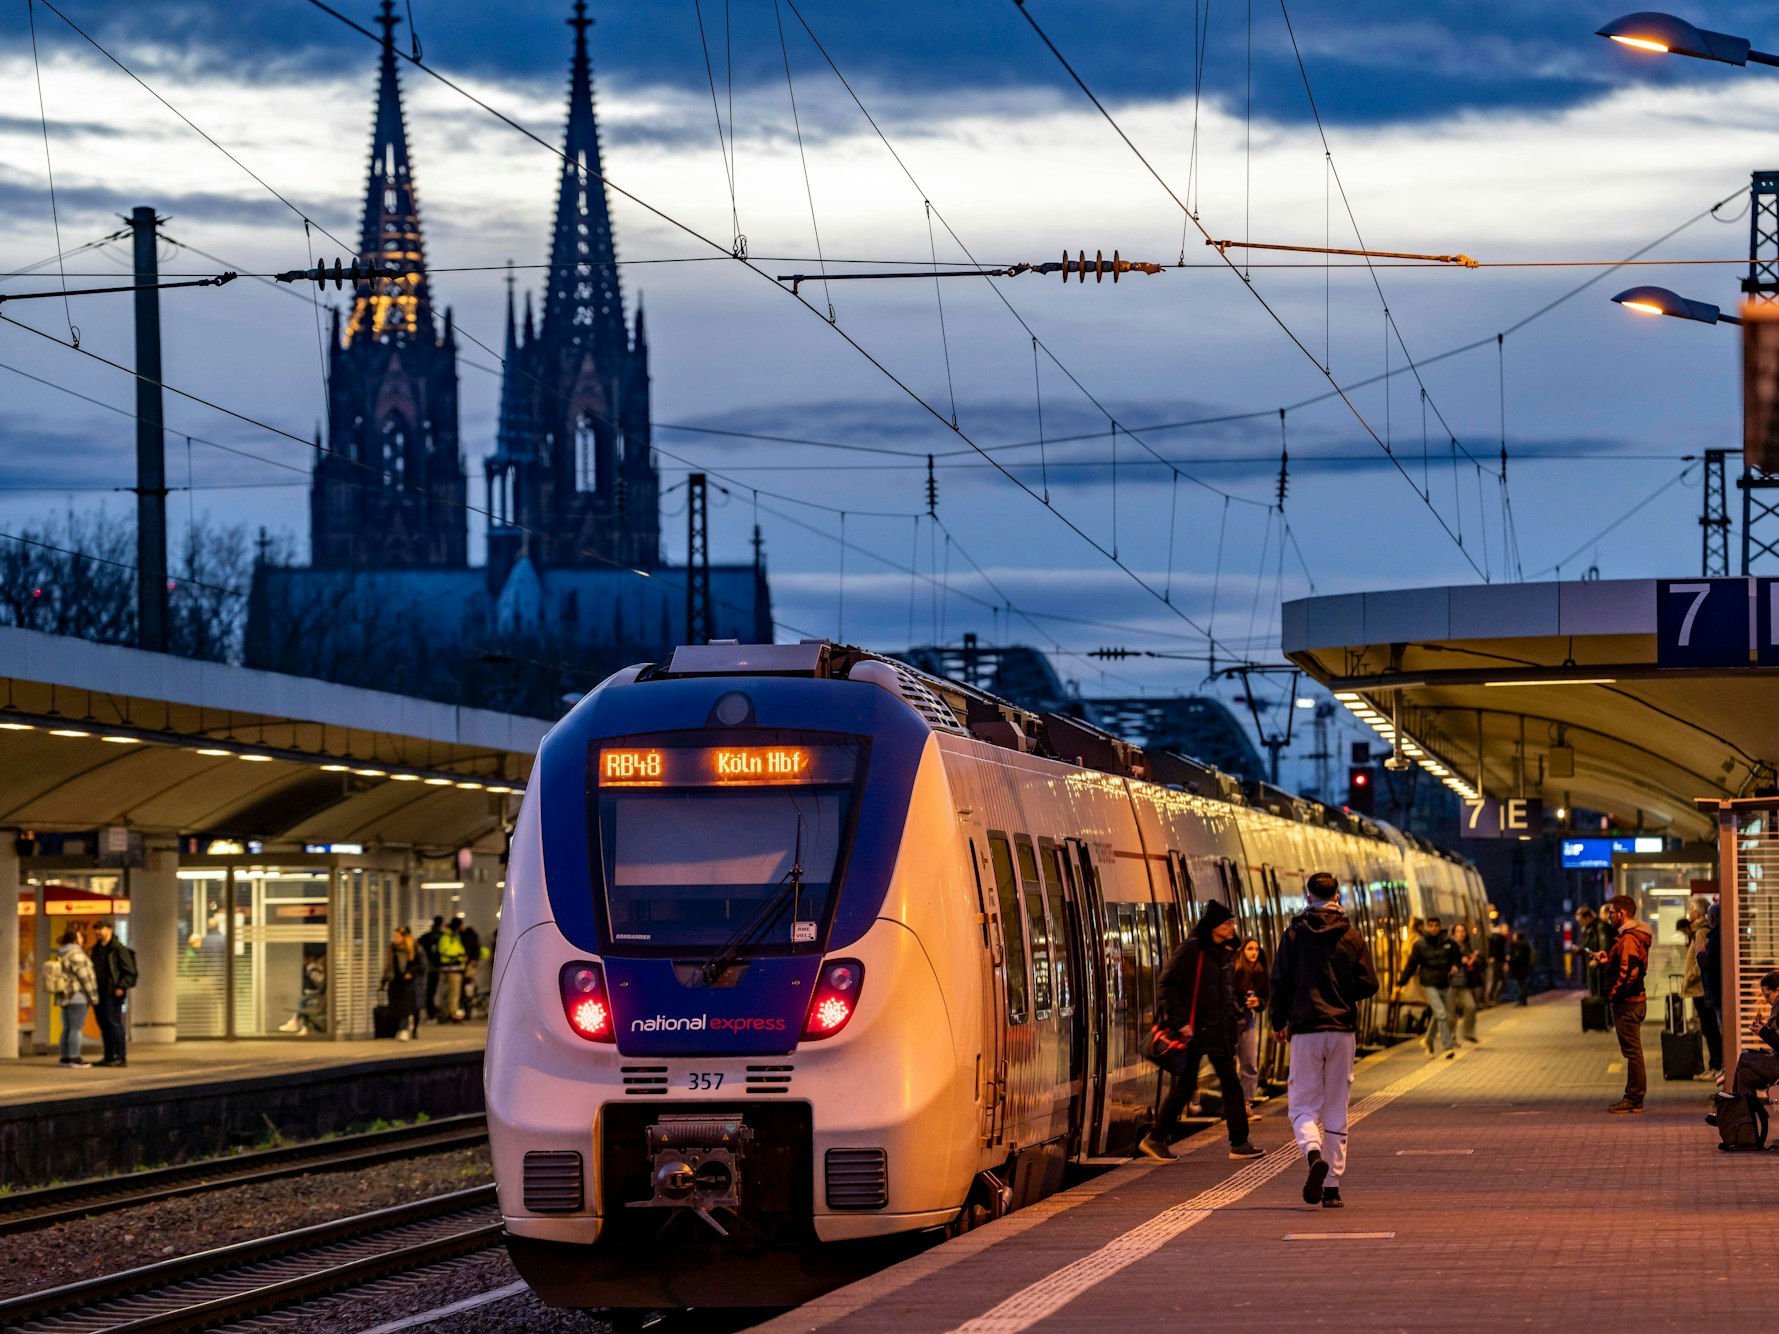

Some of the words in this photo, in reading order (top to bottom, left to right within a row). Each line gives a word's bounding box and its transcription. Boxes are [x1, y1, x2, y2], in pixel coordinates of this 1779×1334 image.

[1669, 583, 1711, 646] 7
[607, 753, 660, 777] RB48
[718, 752, 762, 773] Köln
[768, 752, 800, 773] Hbf
[1465, 799, 1485, 829] 7
[1508, 799, 1528, 829] E
[631, 1014, 706, 1032] national
[709, 1017, 786, 1034] express
[688, 1072, 724, 1090] 357
